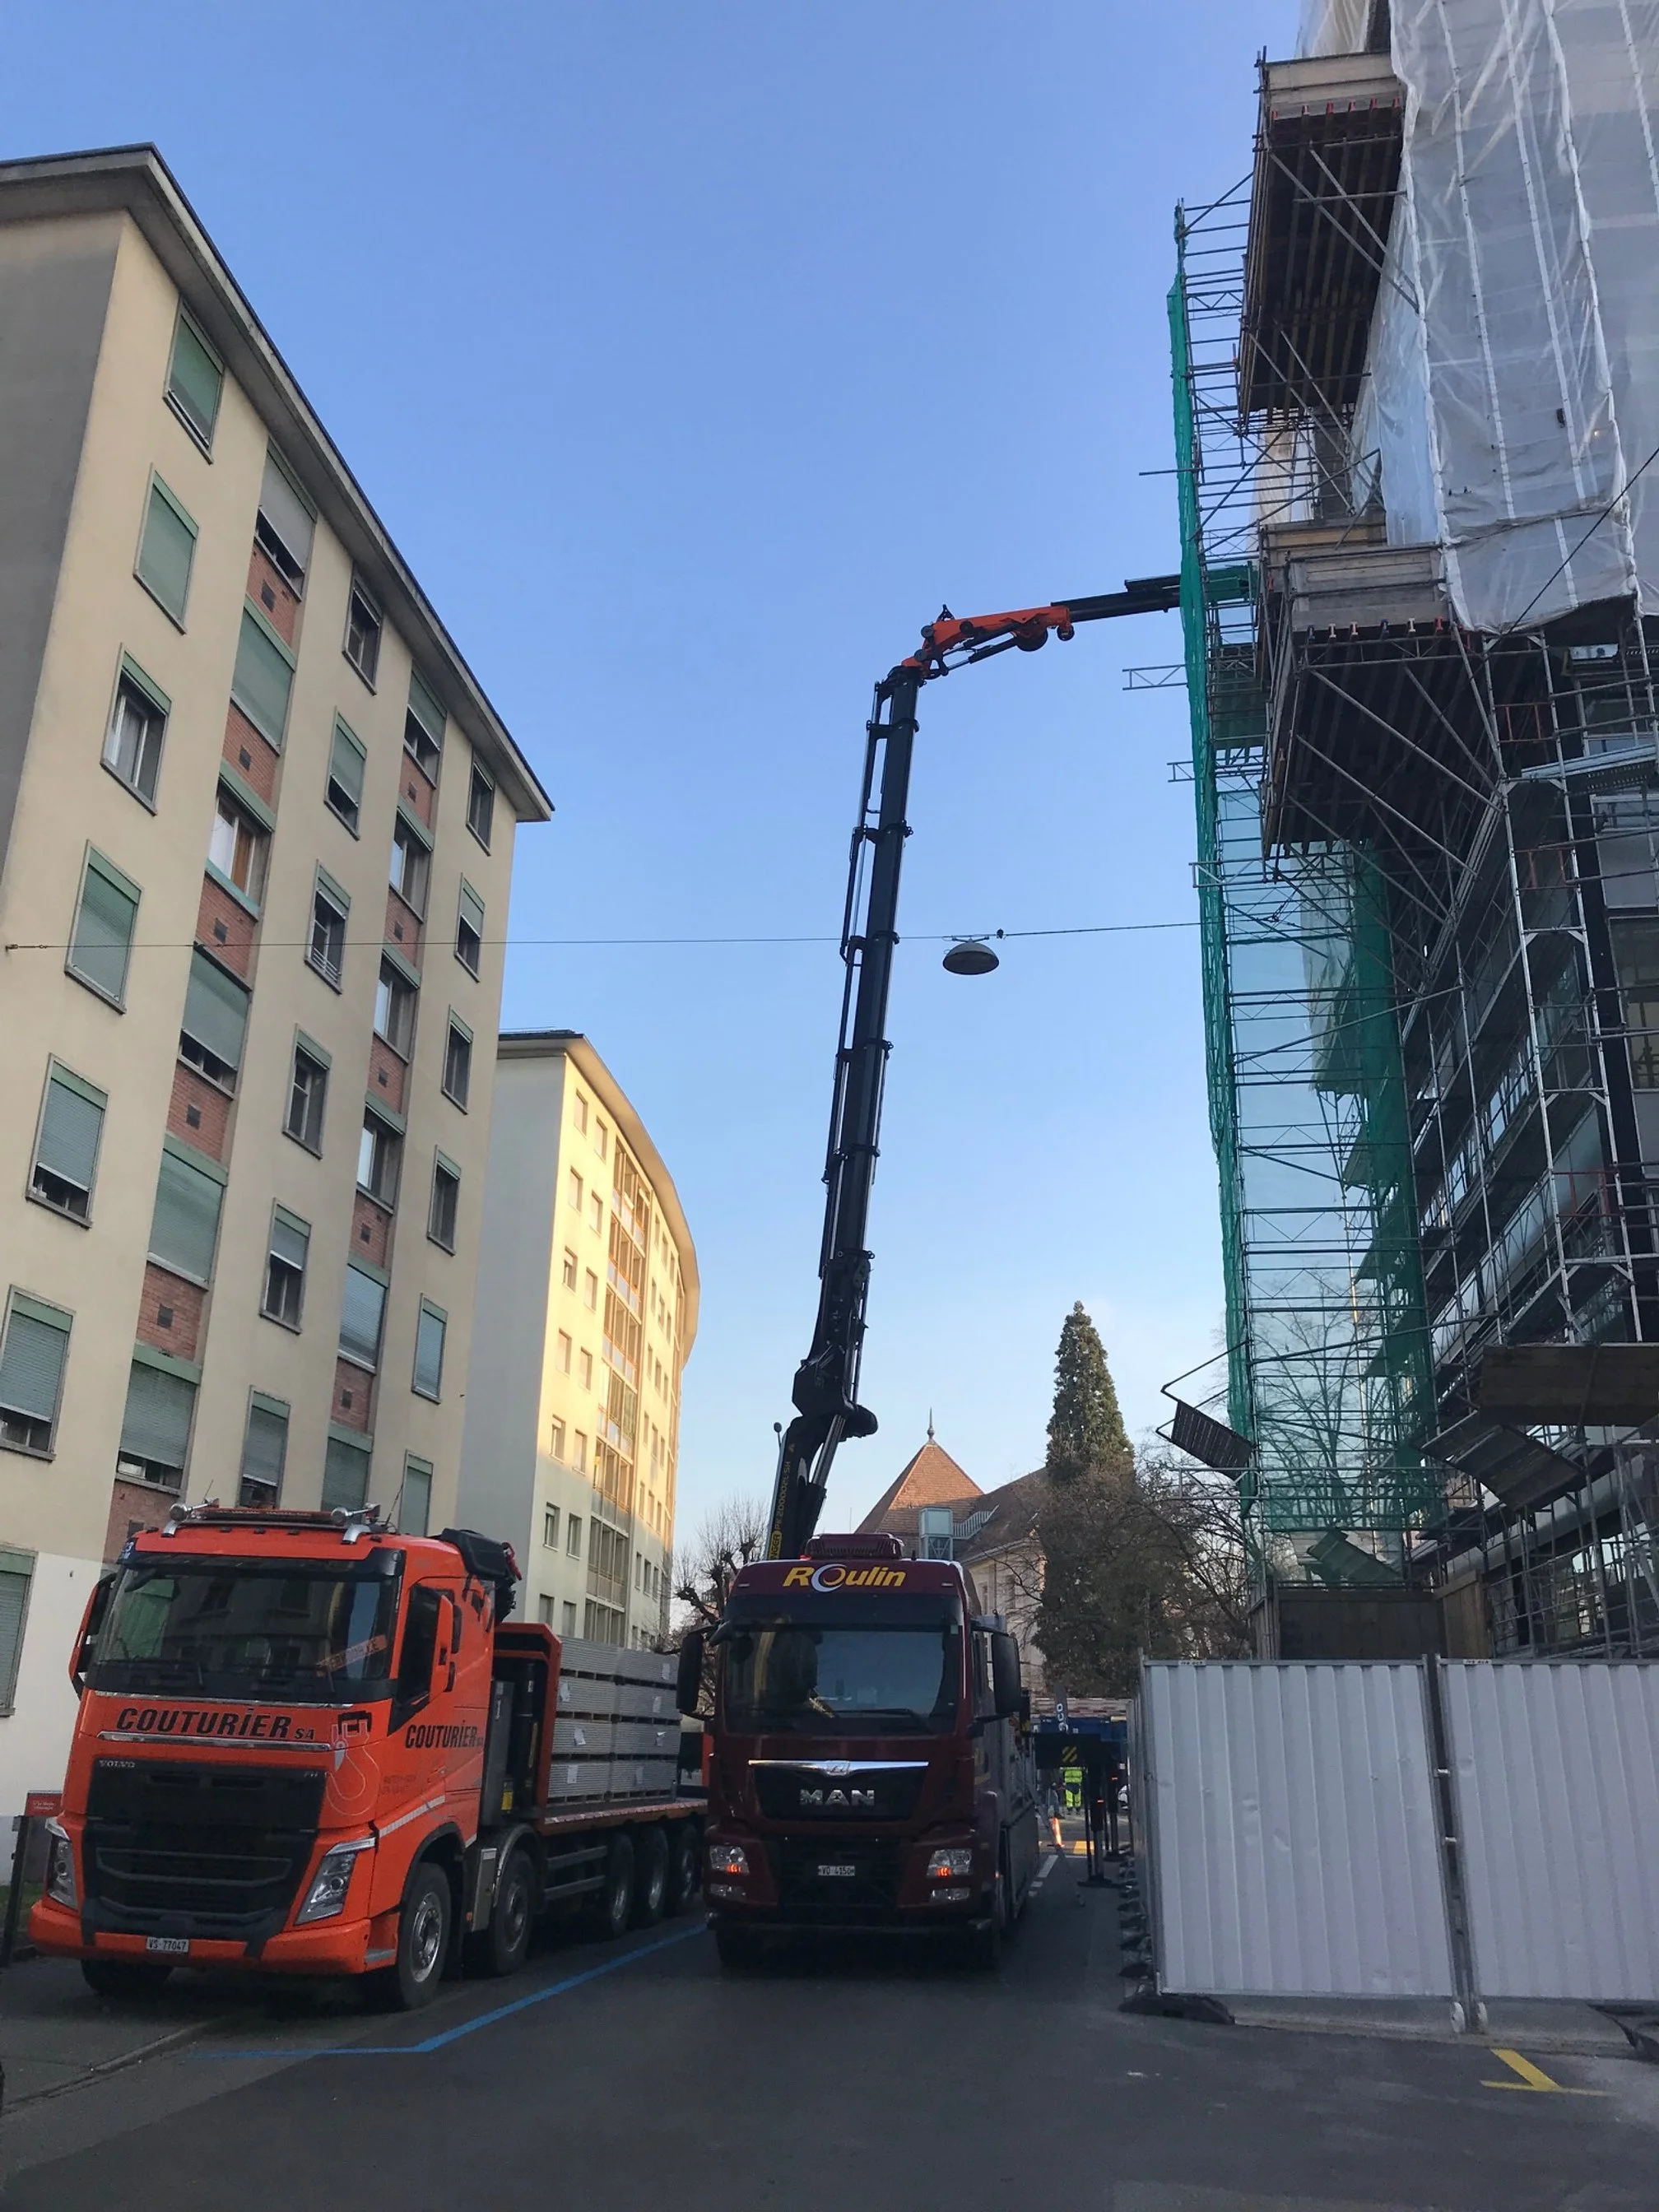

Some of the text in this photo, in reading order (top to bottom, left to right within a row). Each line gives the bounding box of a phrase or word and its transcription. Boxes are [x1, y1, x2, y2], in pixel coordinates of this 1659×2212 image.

[783, 1564, 906, 1592] Roulin
[116, 1708, 315, 1740] COUTURIER SA
[405, 1720, 477, 1748] COUTURIER
[100, 1759, 135, 1768] VOLVO
[800, 1789, 874, 1805] MAN
[149, 1939, 187, 1950] VS 77047
